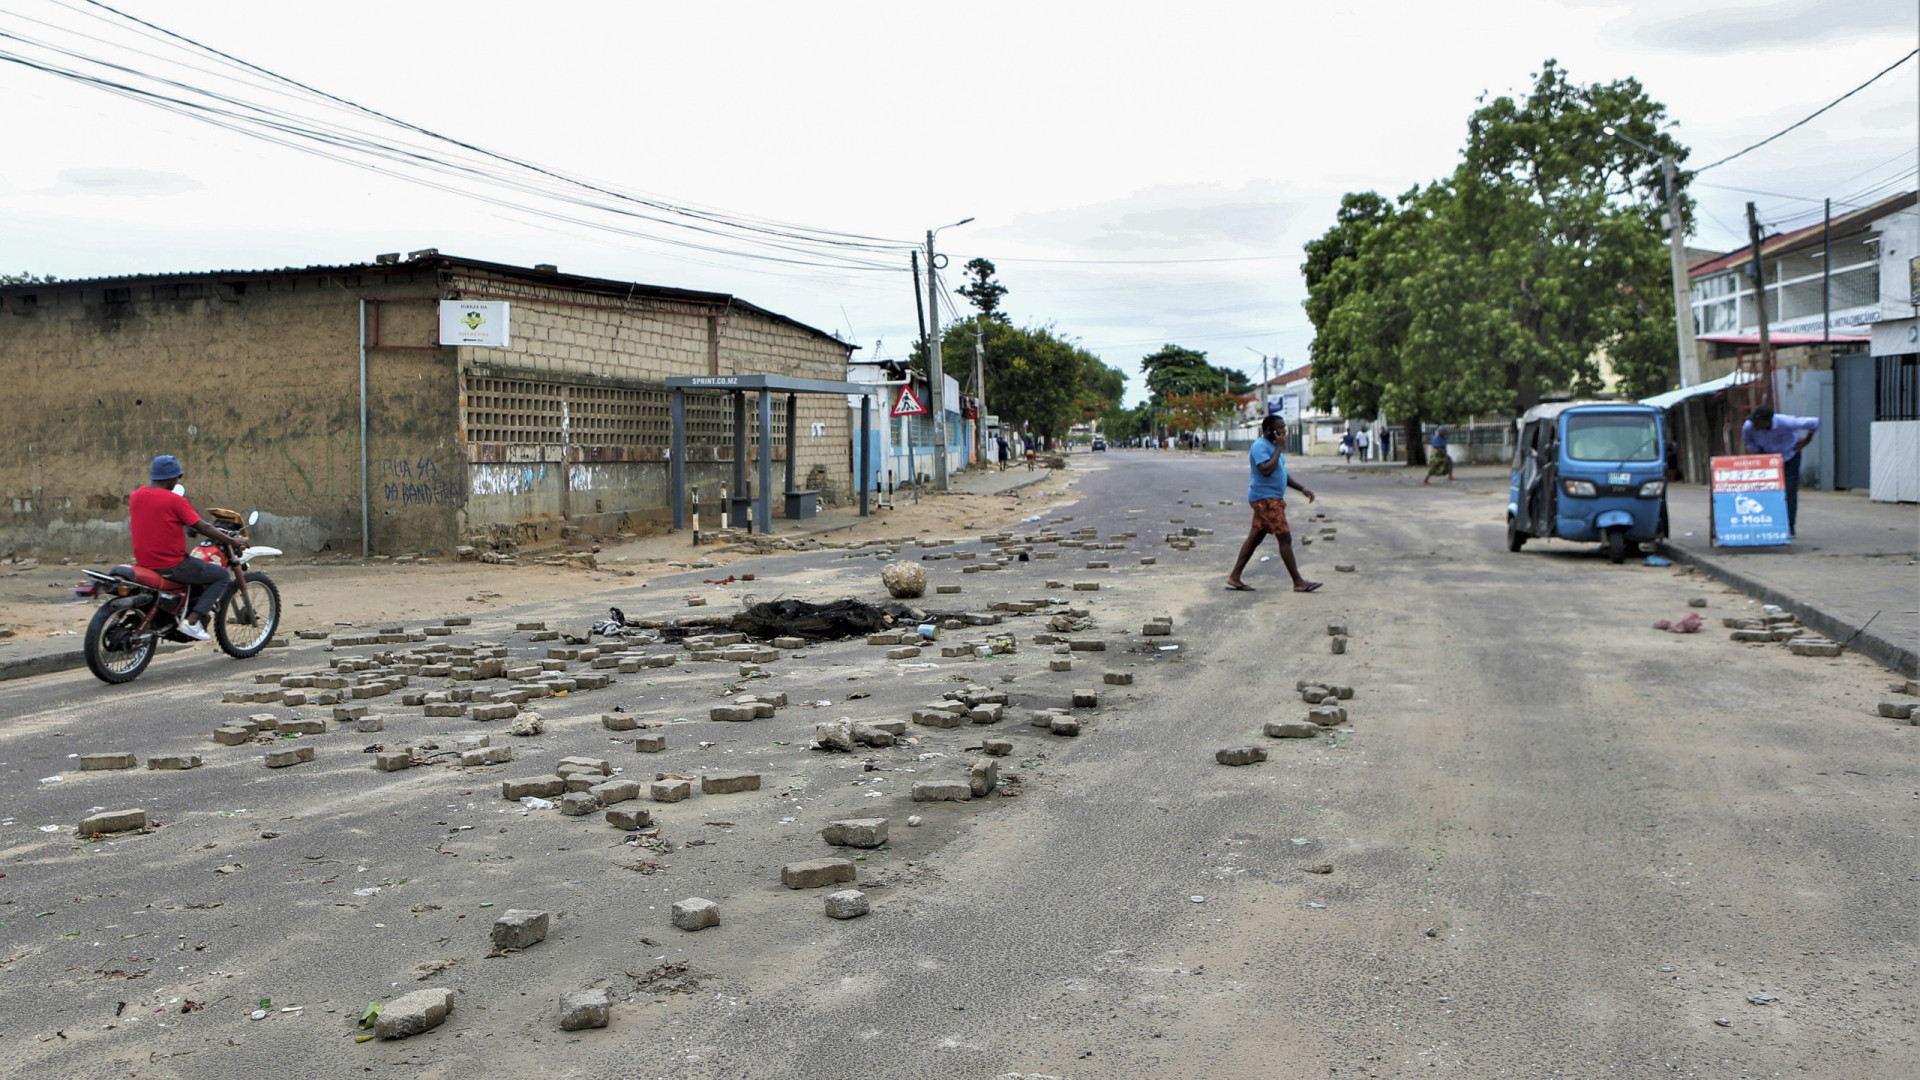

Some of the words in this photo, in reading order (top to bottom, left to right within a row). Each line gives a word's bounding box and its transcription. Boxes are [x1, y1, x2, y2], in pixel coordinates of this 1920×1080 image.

[692, 377, 738, 385] SPRINT.CO.MZ
[383, 457, 412, 478] RUA
[384, 481, 399, 501] DA
